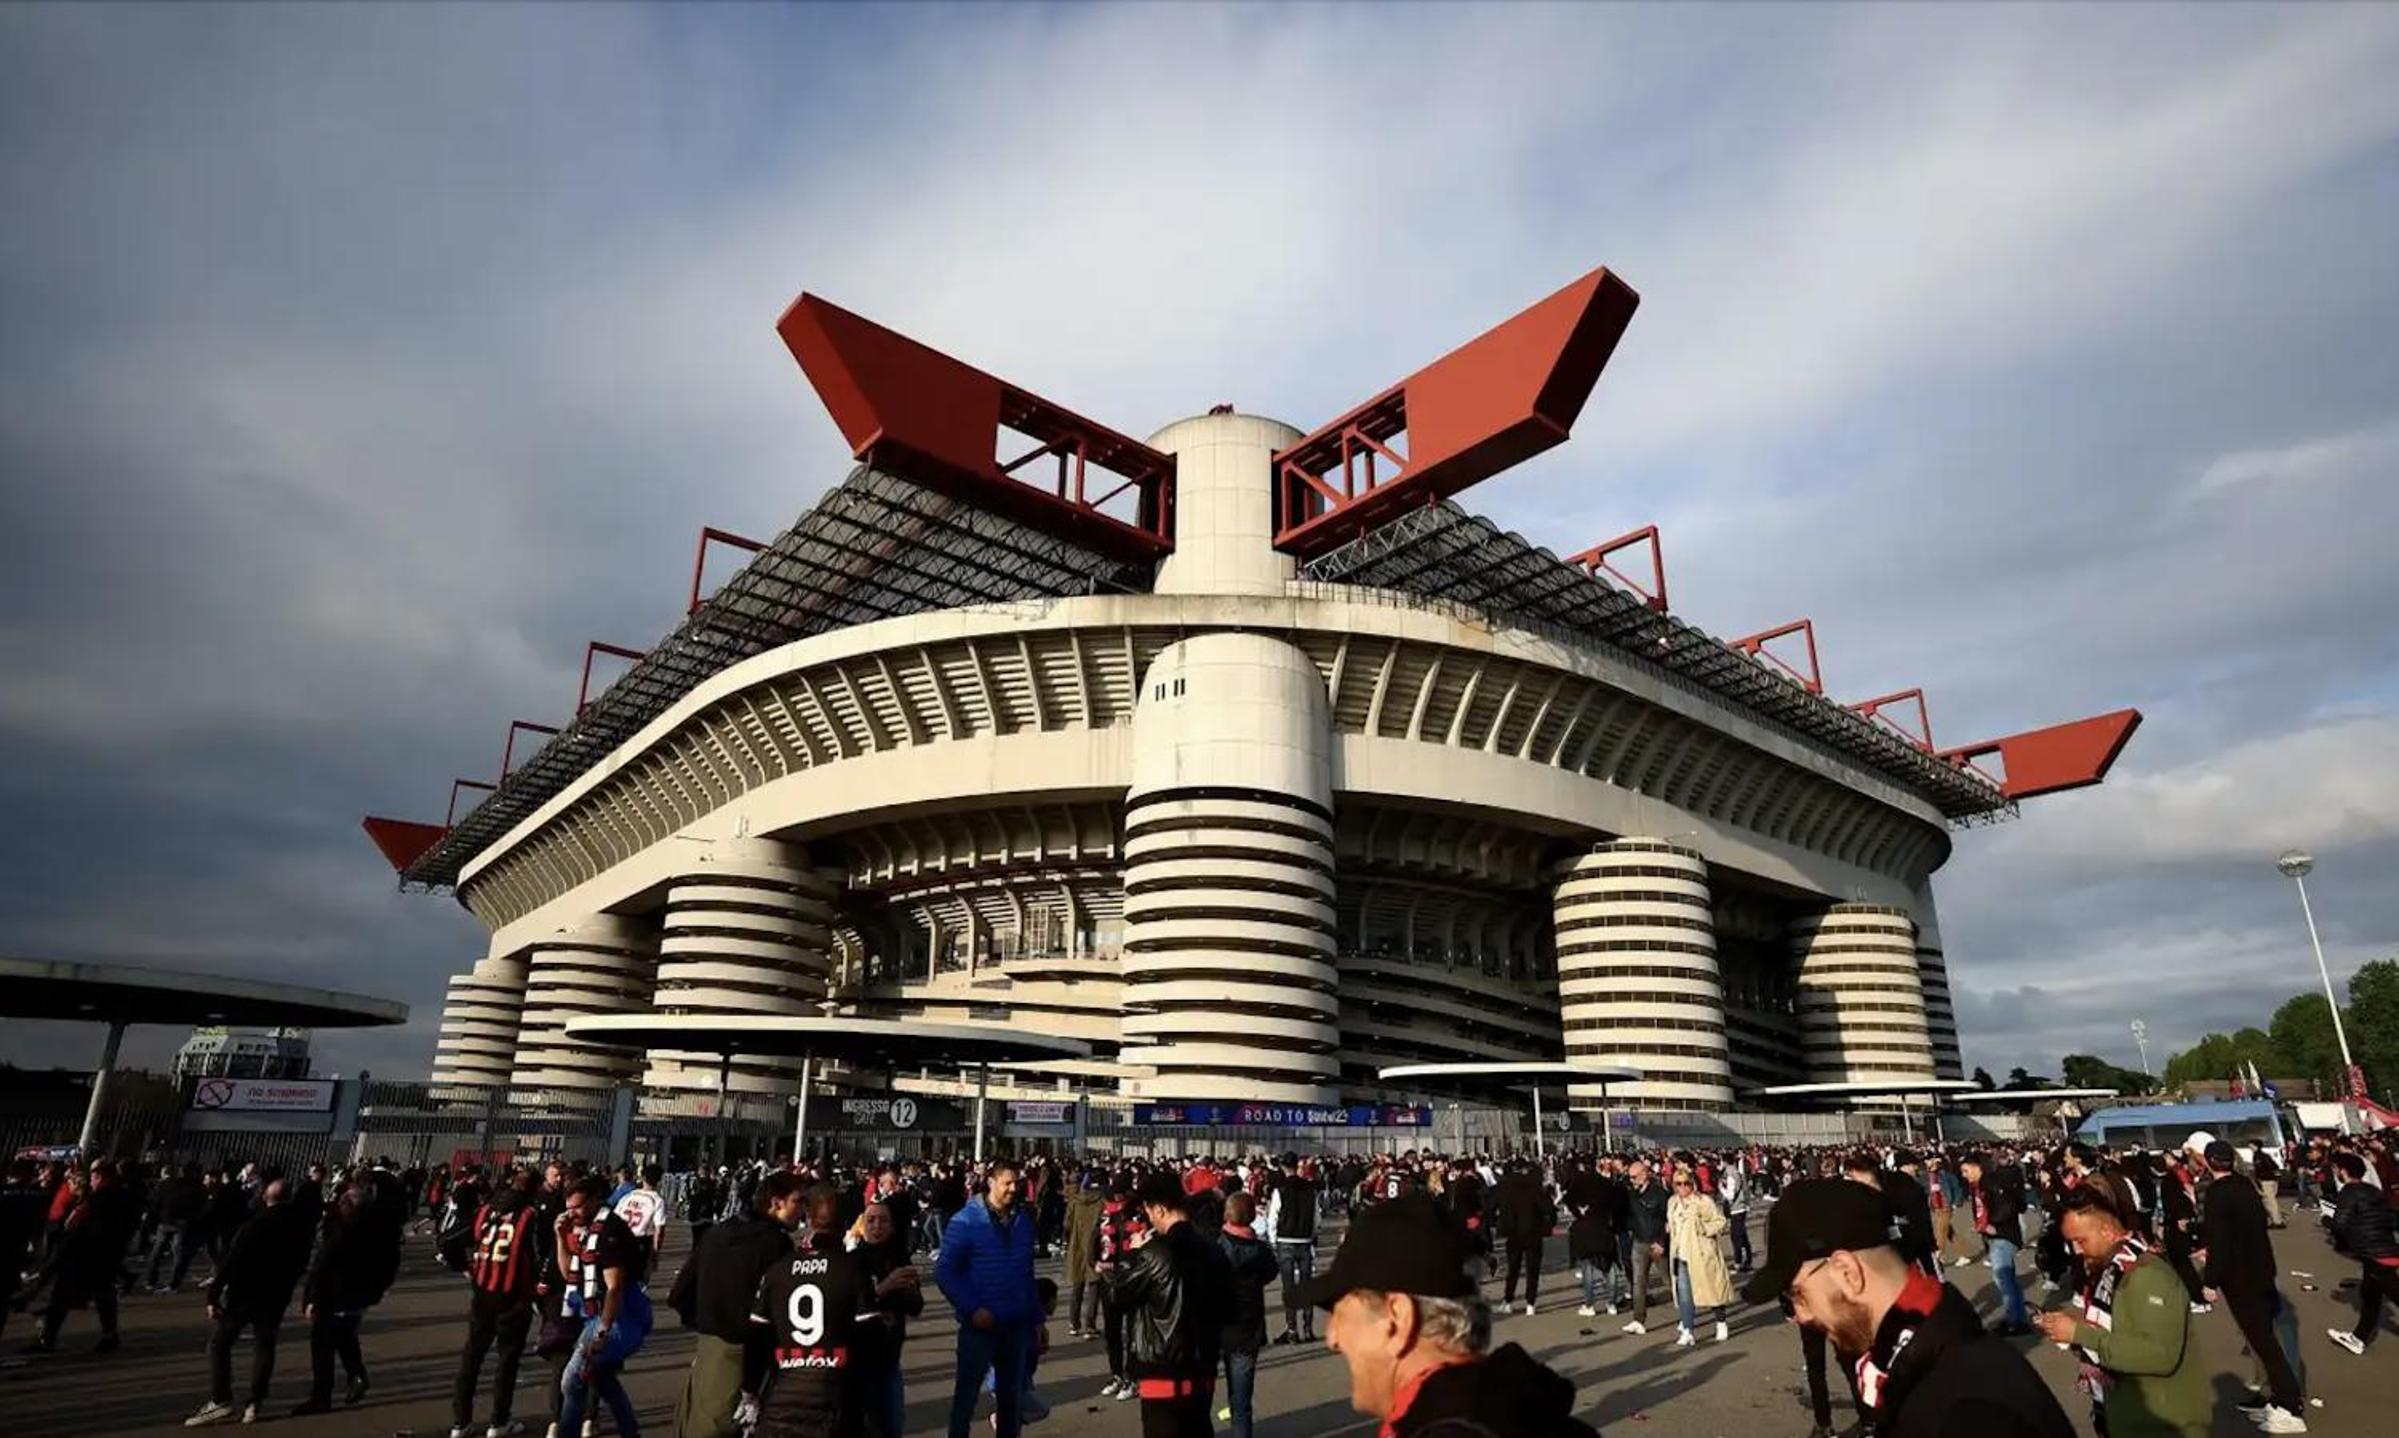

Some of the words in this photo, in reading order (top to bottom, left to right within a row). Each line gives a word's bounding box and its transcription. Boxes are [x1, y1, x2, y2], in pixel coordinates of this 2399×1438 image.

[895, 1102, 913, 1123] 12
[1244, 1109, 1282, 1122] ROAD
[1287, 1109, 1304, 1123] TO
[1387, 1181, 1398, 1198] 8
[791, 1258, 828, 1275] PAPA
[788, 1283, 824, 1346] 9
